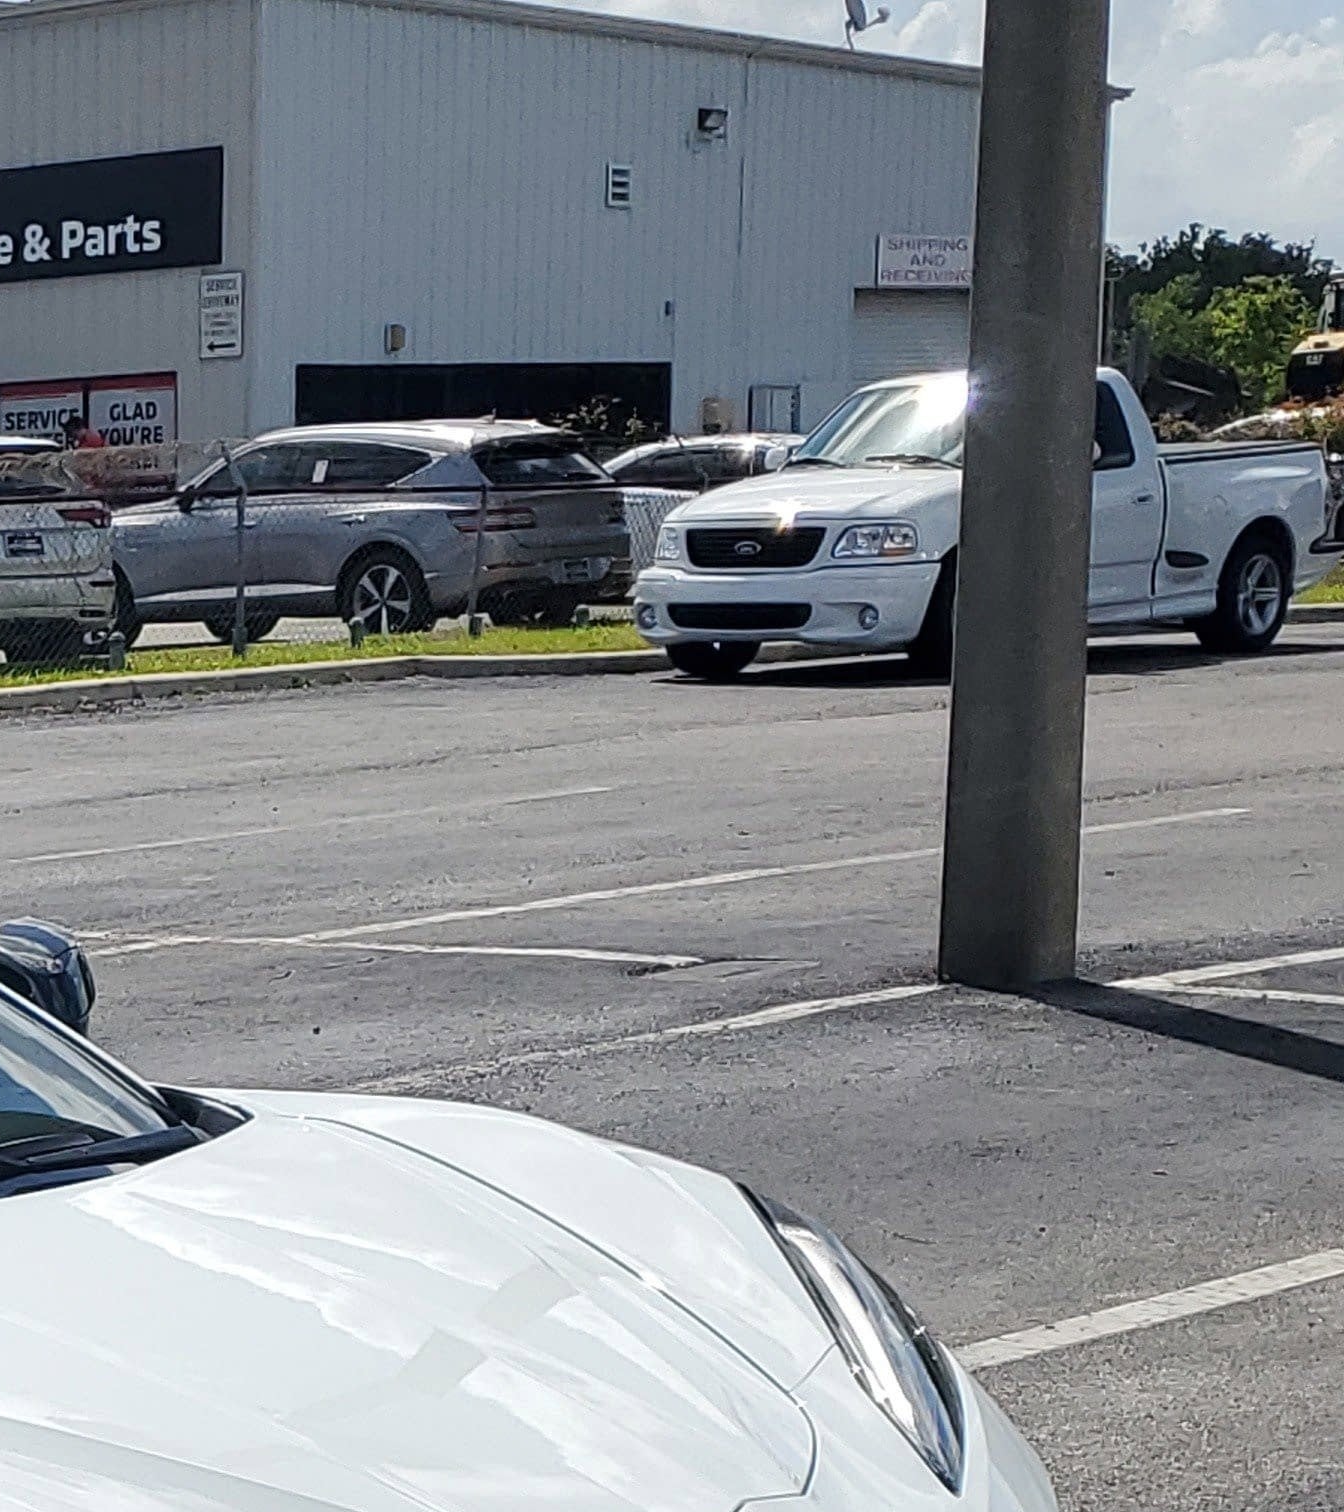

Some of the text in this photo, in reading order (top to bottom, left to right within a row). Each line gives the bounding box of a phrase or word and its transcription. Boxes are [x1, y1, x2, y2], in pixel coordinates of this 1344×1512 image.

[22, 223, 53, 263] &
[61, 214, 162, 260] Parts
[886, 238, 969, 251] SHIPPING
[909, 253, 946, 267] AND
[109, 401, 157, 422] GLAD
[98, 425, 164, 446] YOU'RE
